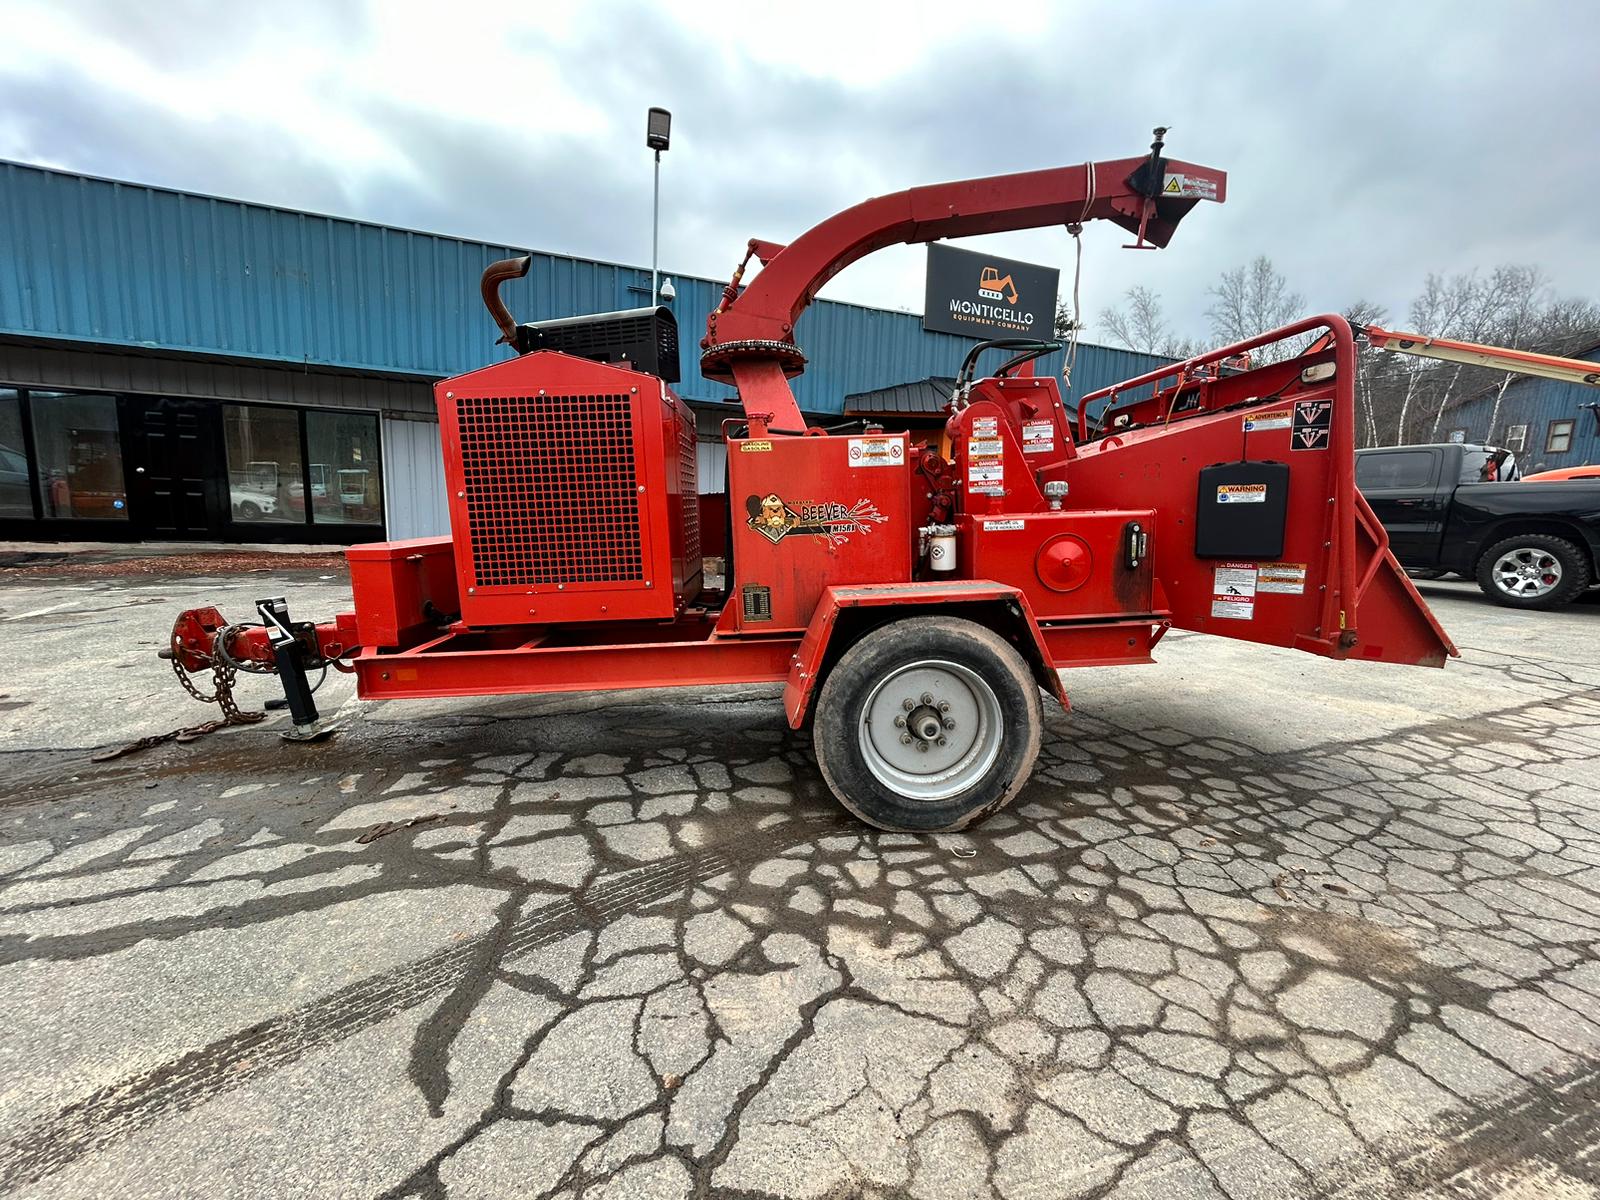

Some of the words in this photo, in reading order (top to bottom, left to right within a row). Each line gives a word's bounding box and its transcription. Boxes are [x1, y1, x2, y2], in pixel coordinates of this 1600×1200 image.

[949, 299, 1034, 325] MONTICELLO
[953, 313, 995, 326] EQUIPMENT
[997, 321, 1030, 332] COMPANY
[1255, 412, 1288, 420] ADVERTENCIA
[1228, 485, 1265, 493] WARNING
[801, 502, 848, 521] BEEVER
[1222, 595, 1250, 603] PELIGRO
